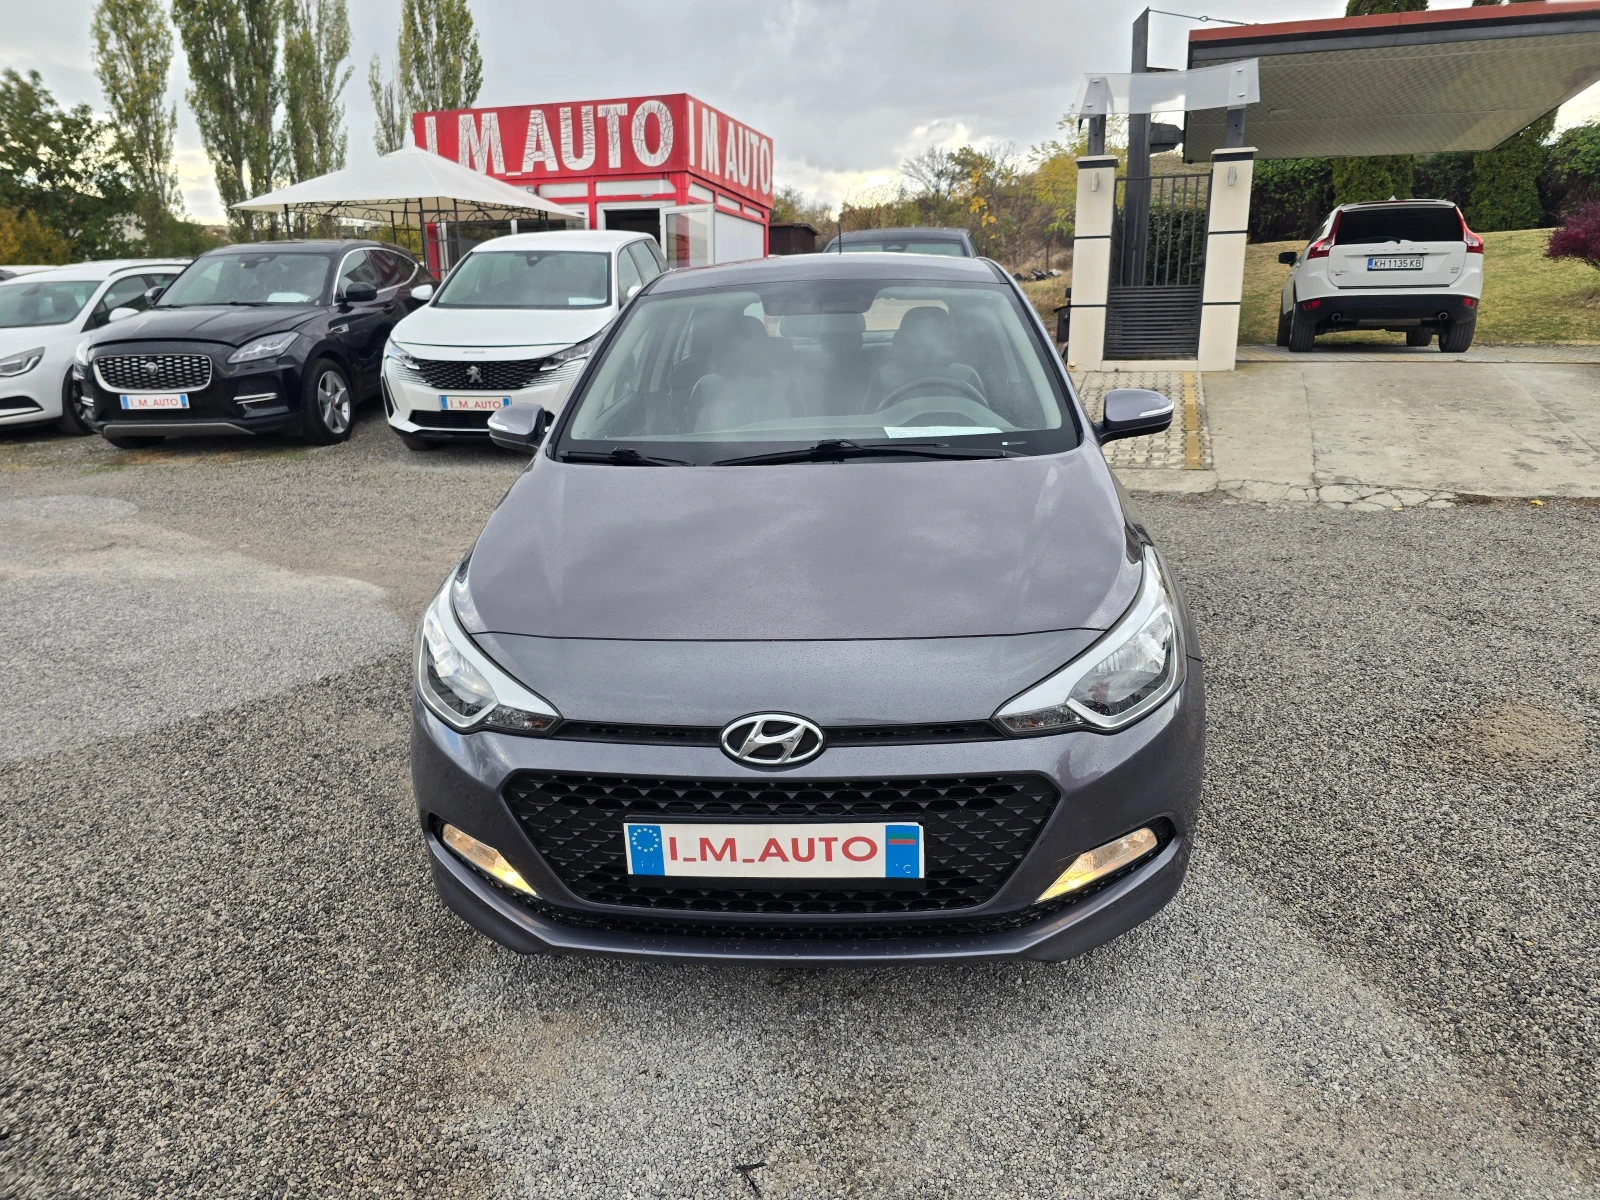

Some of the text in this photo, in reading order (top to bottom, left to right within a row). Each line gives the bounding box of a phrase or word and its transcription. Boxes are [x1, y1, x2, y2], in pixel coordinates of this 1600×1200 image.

[724, 121, 771, 195] AUTO
[1374, 259, 1422, 268] KH 1135 KB
[669, 836, 878, 863] I_M_AUTO
